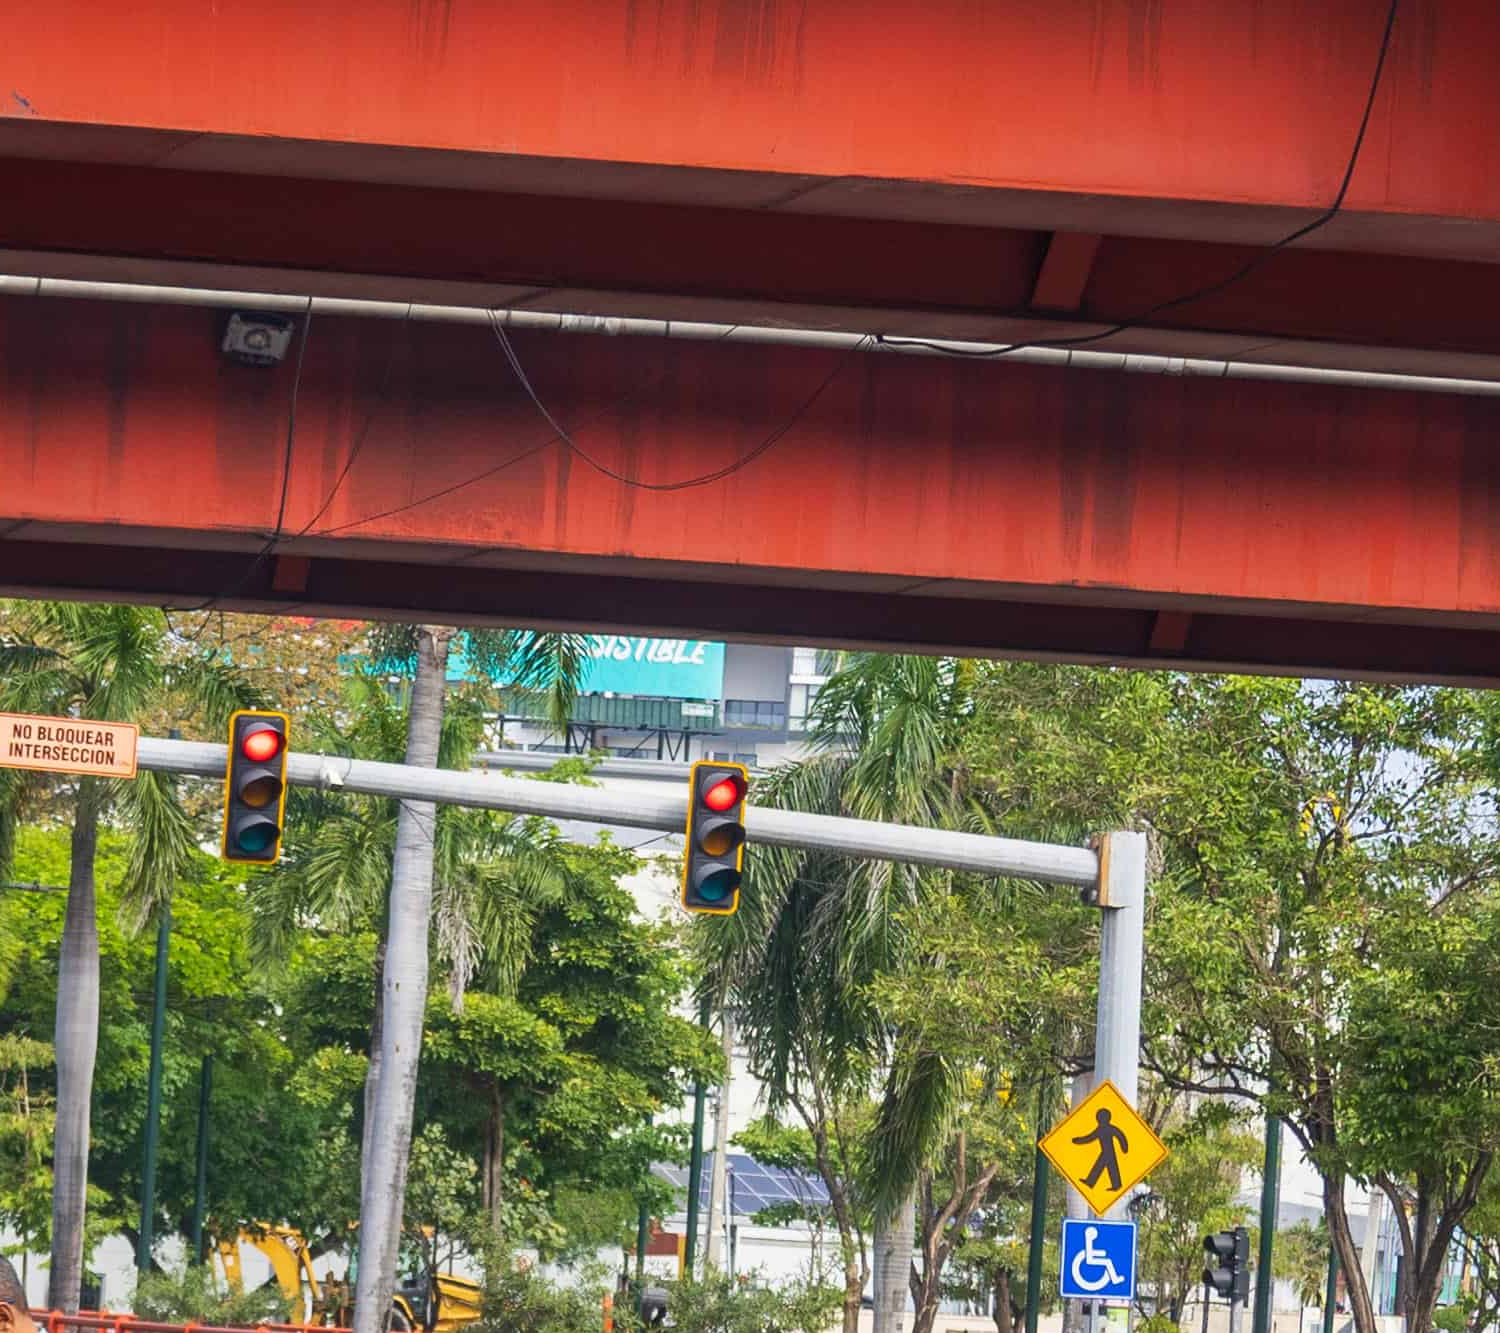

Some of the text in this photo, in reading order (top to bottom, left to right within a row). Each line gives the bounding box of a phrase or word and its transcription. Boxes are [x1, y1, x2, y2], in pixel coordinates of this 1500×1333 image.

[13, 724, 114, 746] NO BLOQUEAR
[9, 743, 115, 766] INTERSECCION
